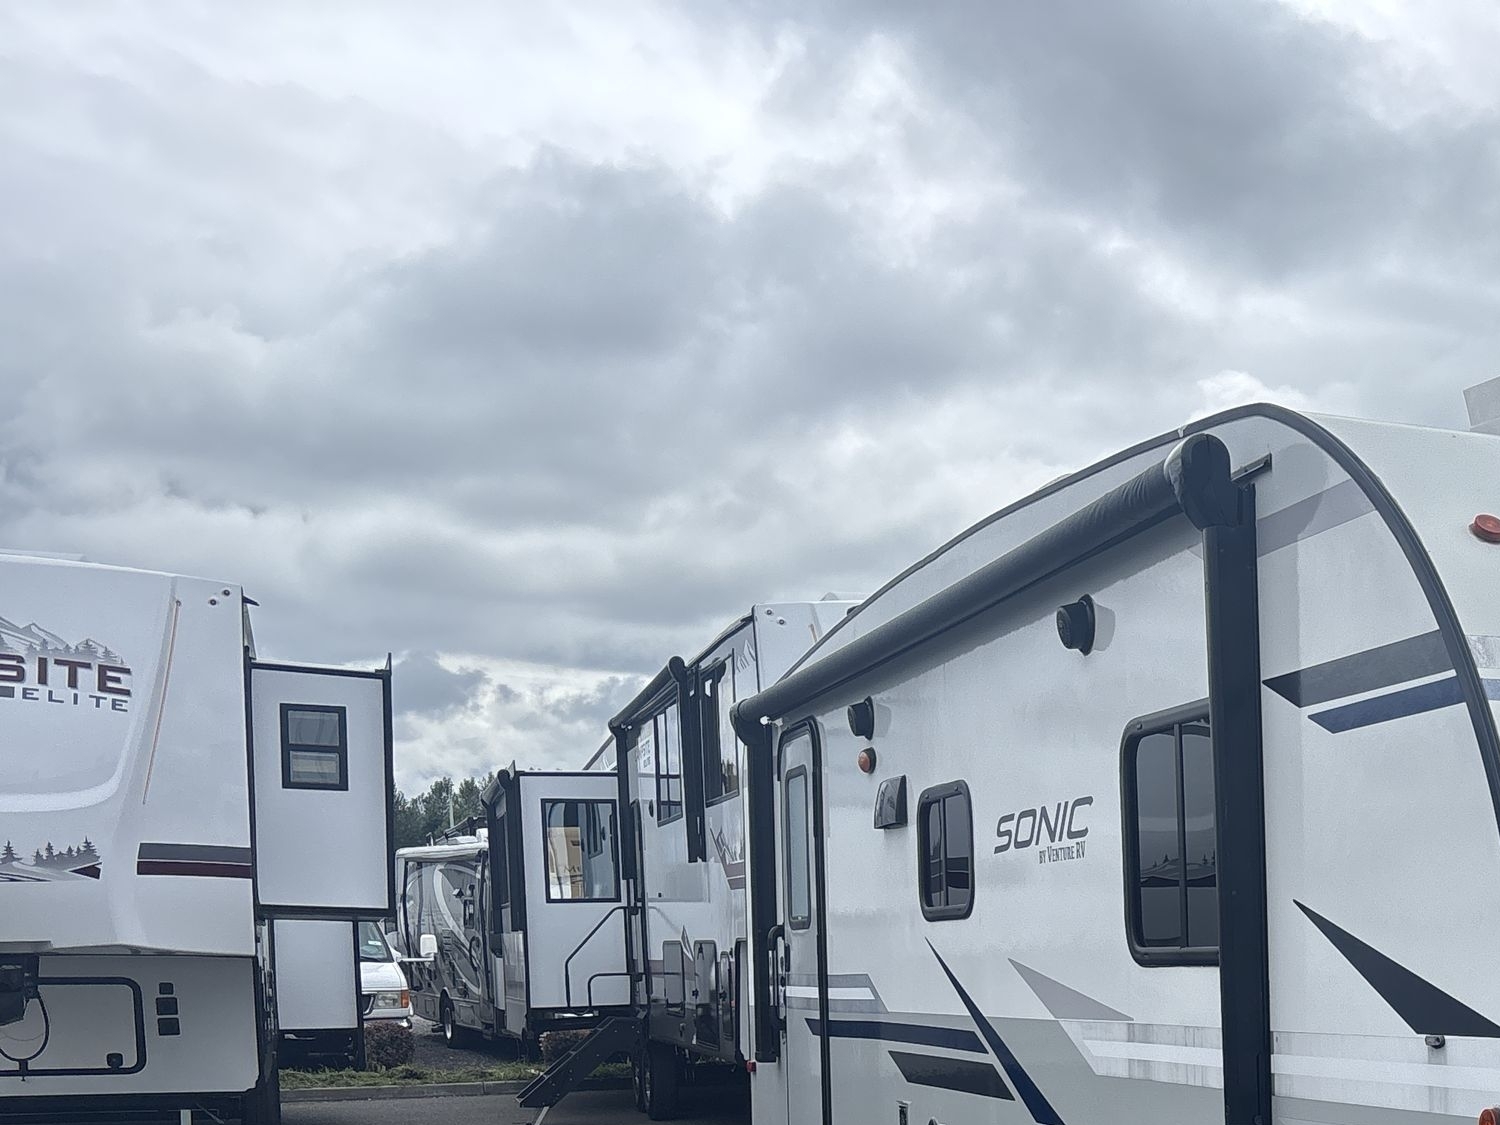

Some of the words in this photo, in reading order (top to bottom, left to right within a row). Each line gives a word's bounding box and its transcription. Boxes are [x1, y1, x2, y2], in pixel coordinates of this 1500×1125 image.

[22, 687, 128, 712] ELITE
[993, 795, 1093, 855] SONIC
[1075, 840, 1086, 860] RV
